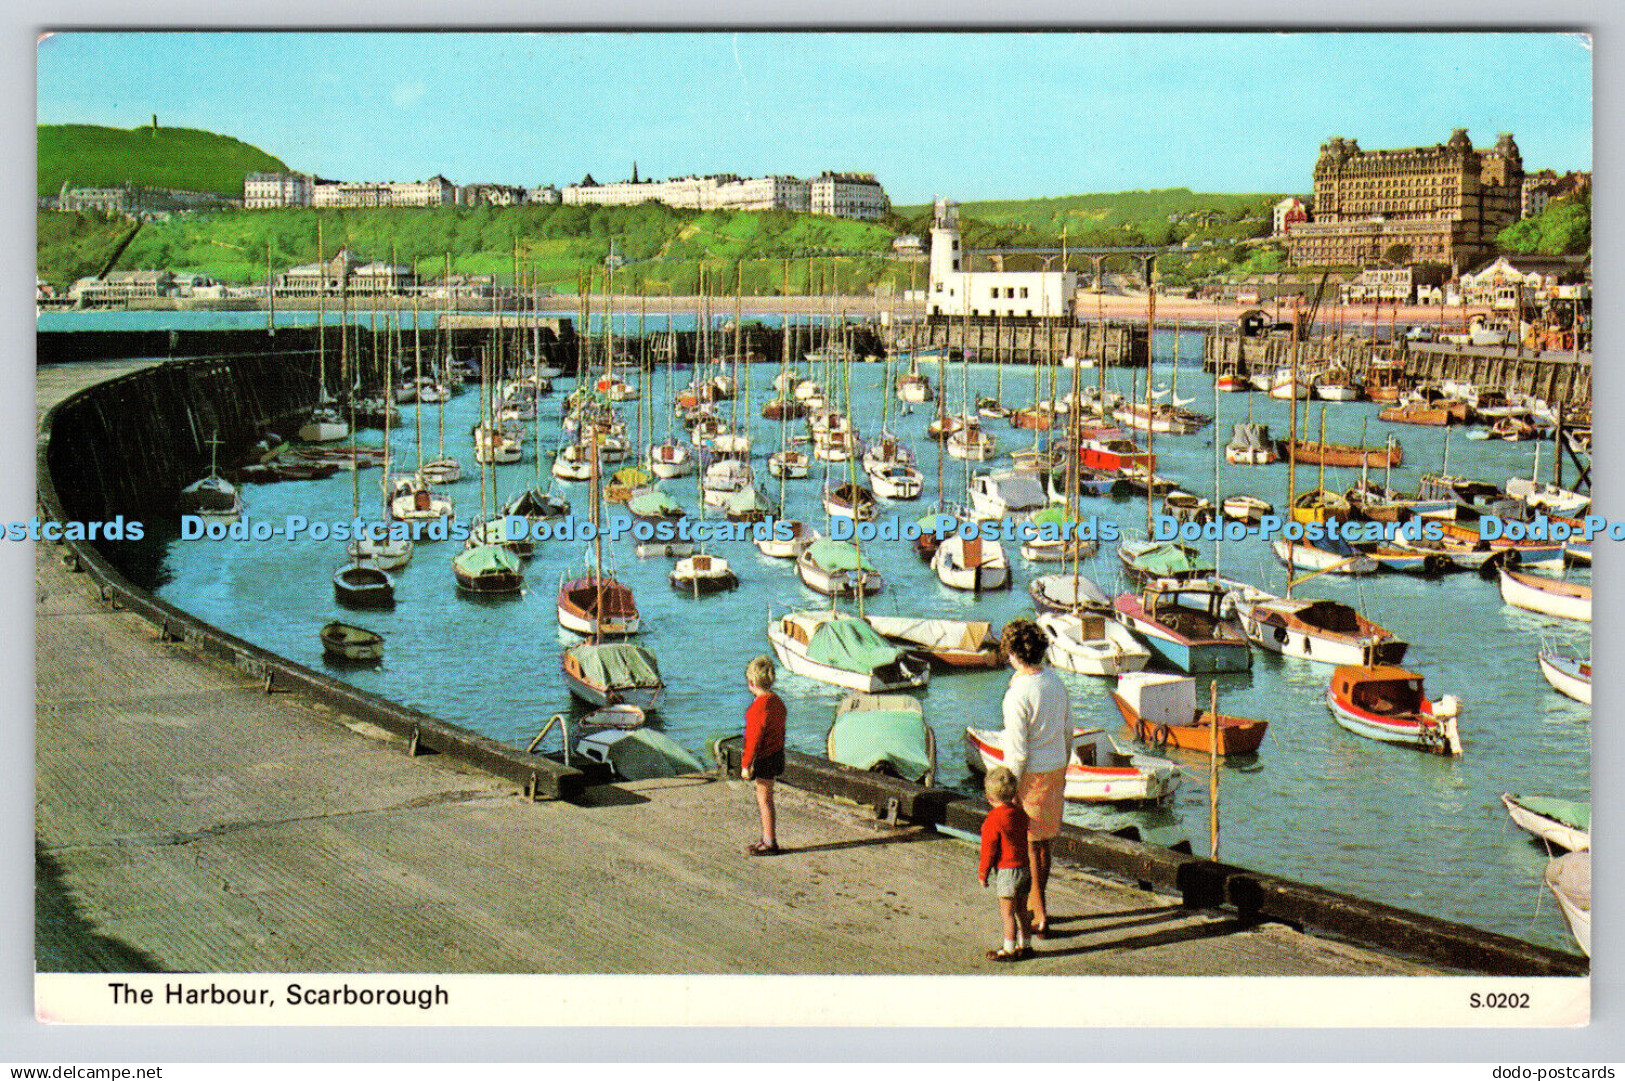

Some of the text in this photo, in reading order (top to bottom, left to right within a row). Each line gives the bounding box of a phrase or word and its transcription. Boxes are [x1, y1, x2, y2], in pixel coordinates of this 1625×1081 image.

[108, 983, 449, 1009] The Harbour, Scarborough
[1469, 993, 1530, 1009] S.0202
